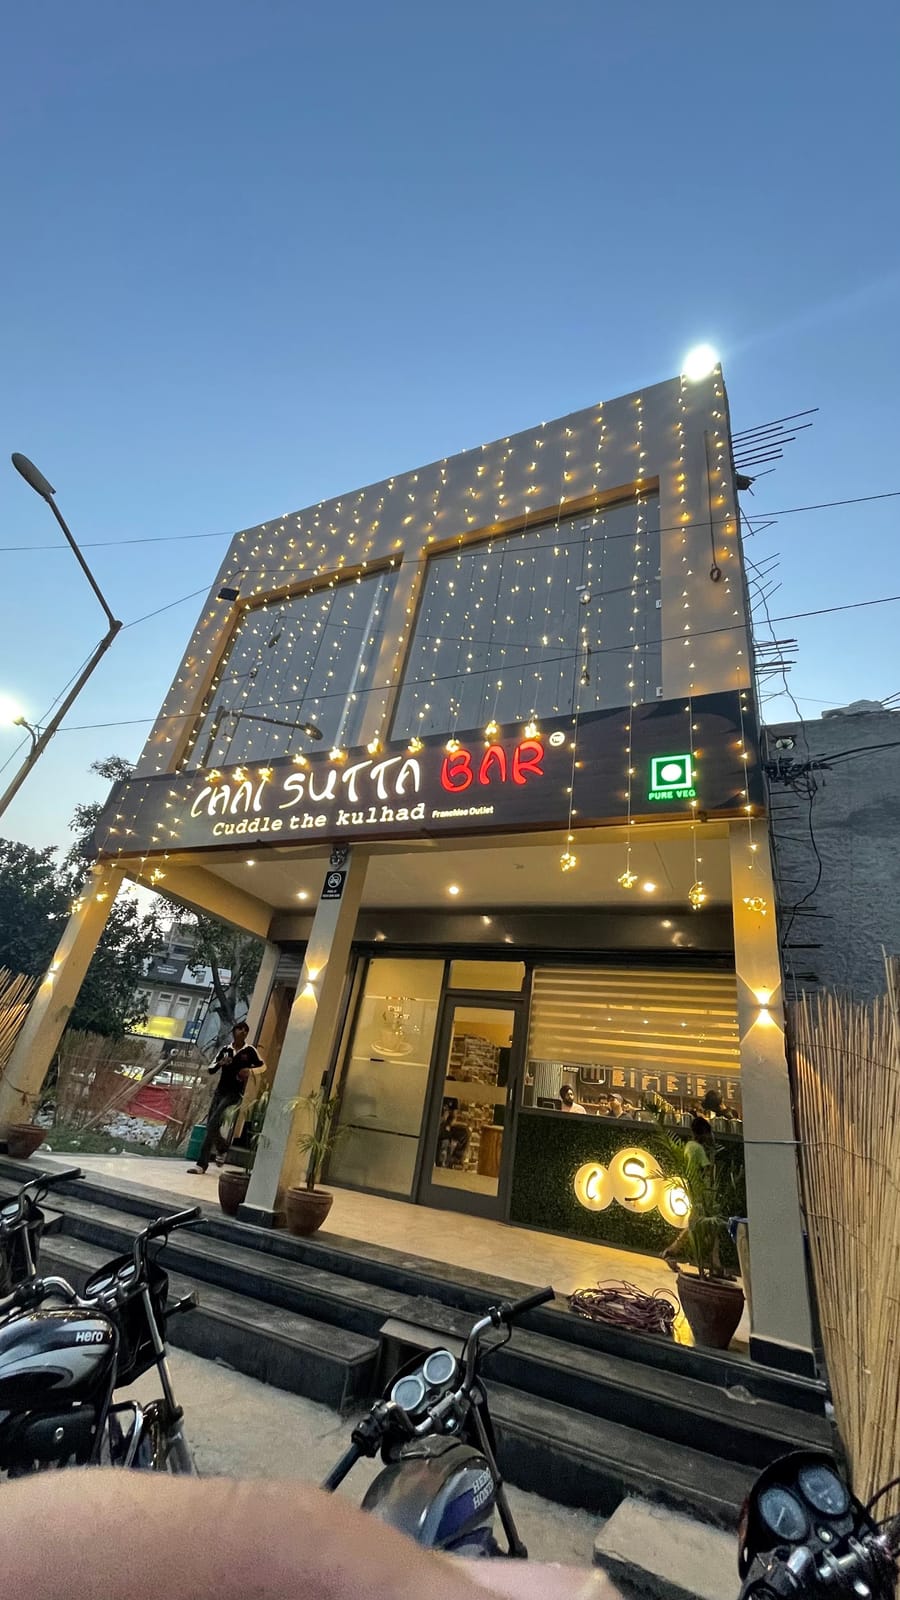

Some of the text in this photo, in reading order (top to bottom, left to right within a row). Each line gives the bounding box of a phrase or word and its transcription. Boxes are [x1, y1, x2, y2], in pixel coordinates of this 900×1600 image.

[191, 740, 544, 818] CHAI SUTTA BAR
[648, 789, 696, 800] PURE VEG
[212, 803, 425, 836] Cuddle the kulhad
[75, 1331, 104, 1343] Hero
